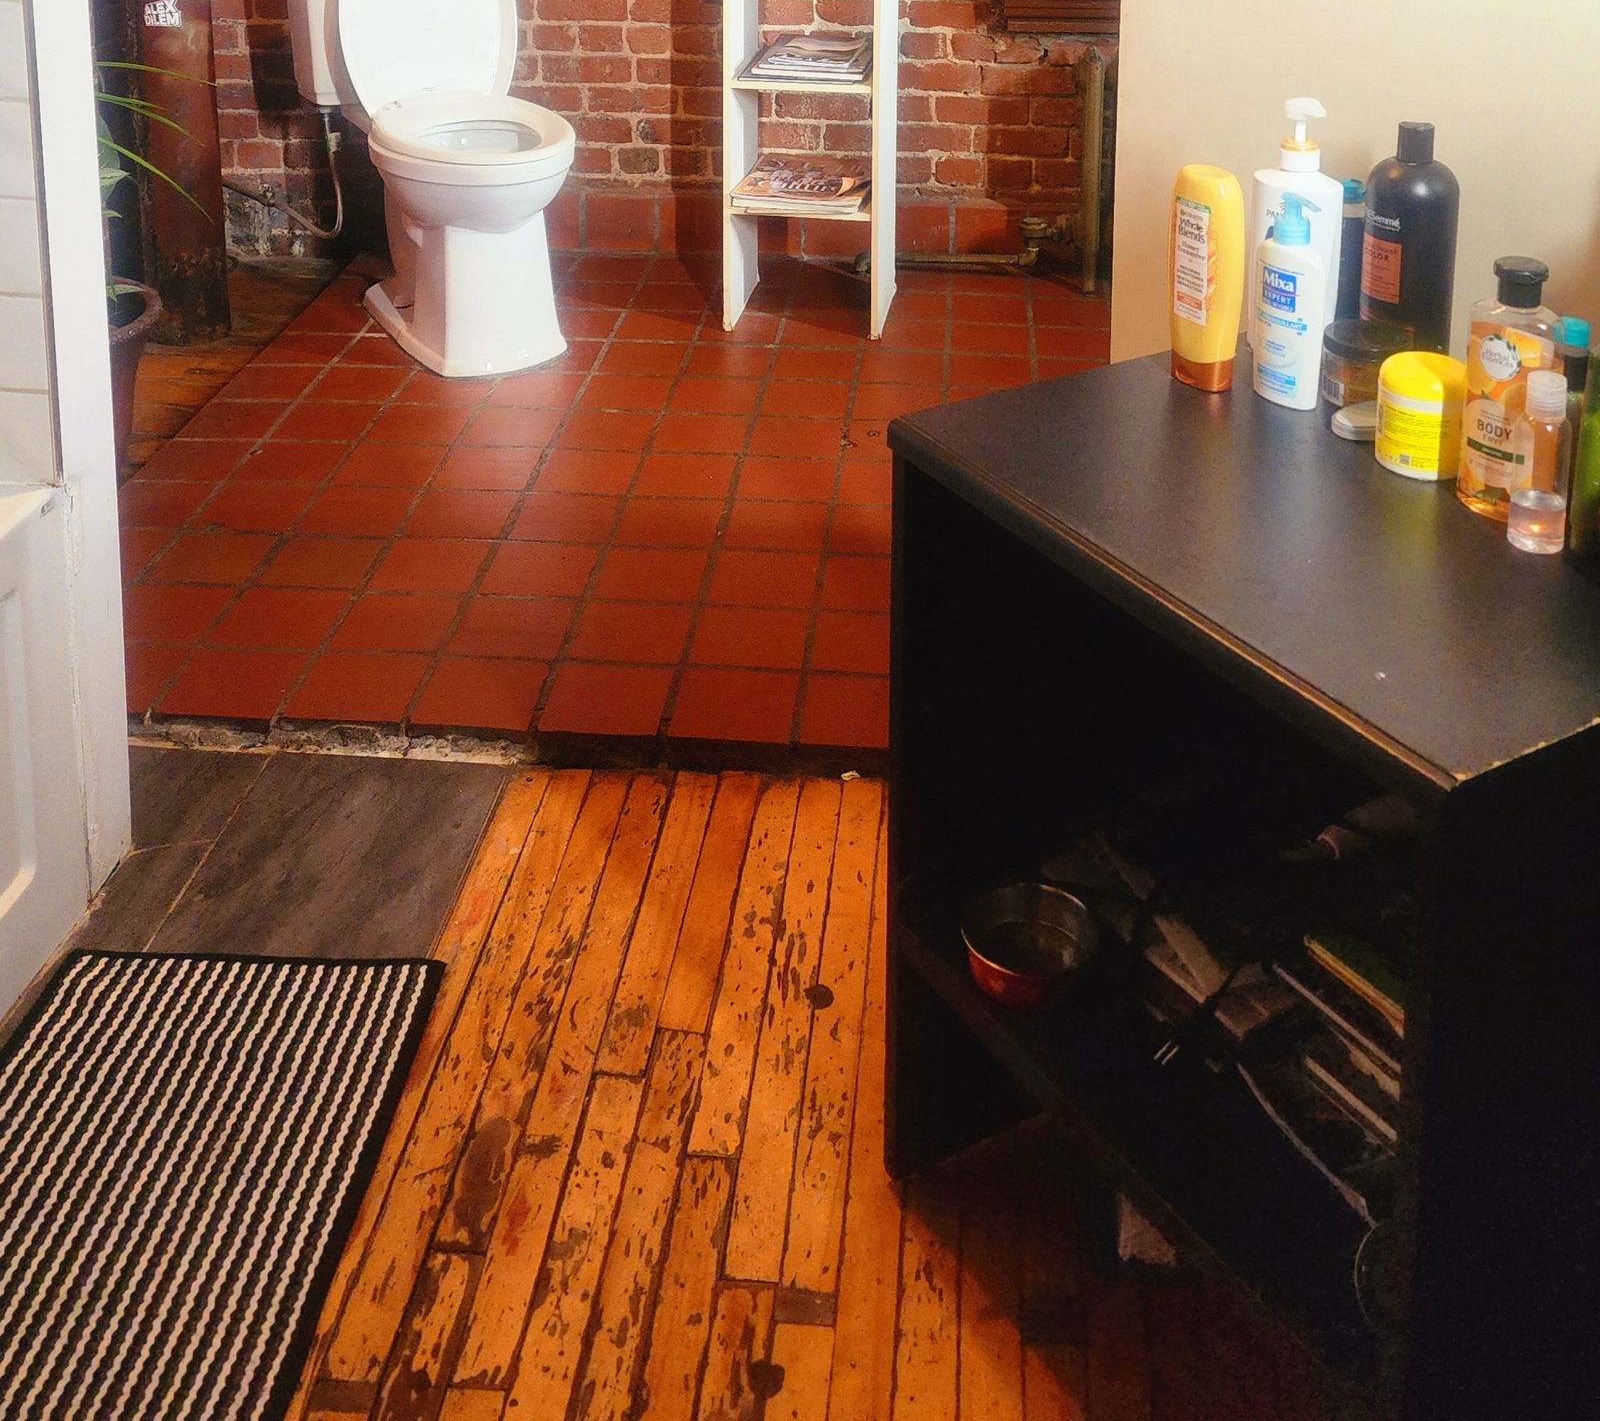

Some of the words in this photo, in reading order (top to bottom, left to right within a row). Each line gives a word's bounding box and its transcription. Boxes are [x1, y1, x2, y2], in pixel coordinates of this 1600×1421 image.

[144, 12, 179, 26] DILEM
[1179, 217, 1203, 233] Whole
[1178, 225, 1206, 245] Blends
[1365, 247, 1389, 261] COLOR
[1264, 272, 1295, 293] Mixa
[1264, 289, 1291, 306] EXPERT
[1477, 419, 1512, 440] BODY
